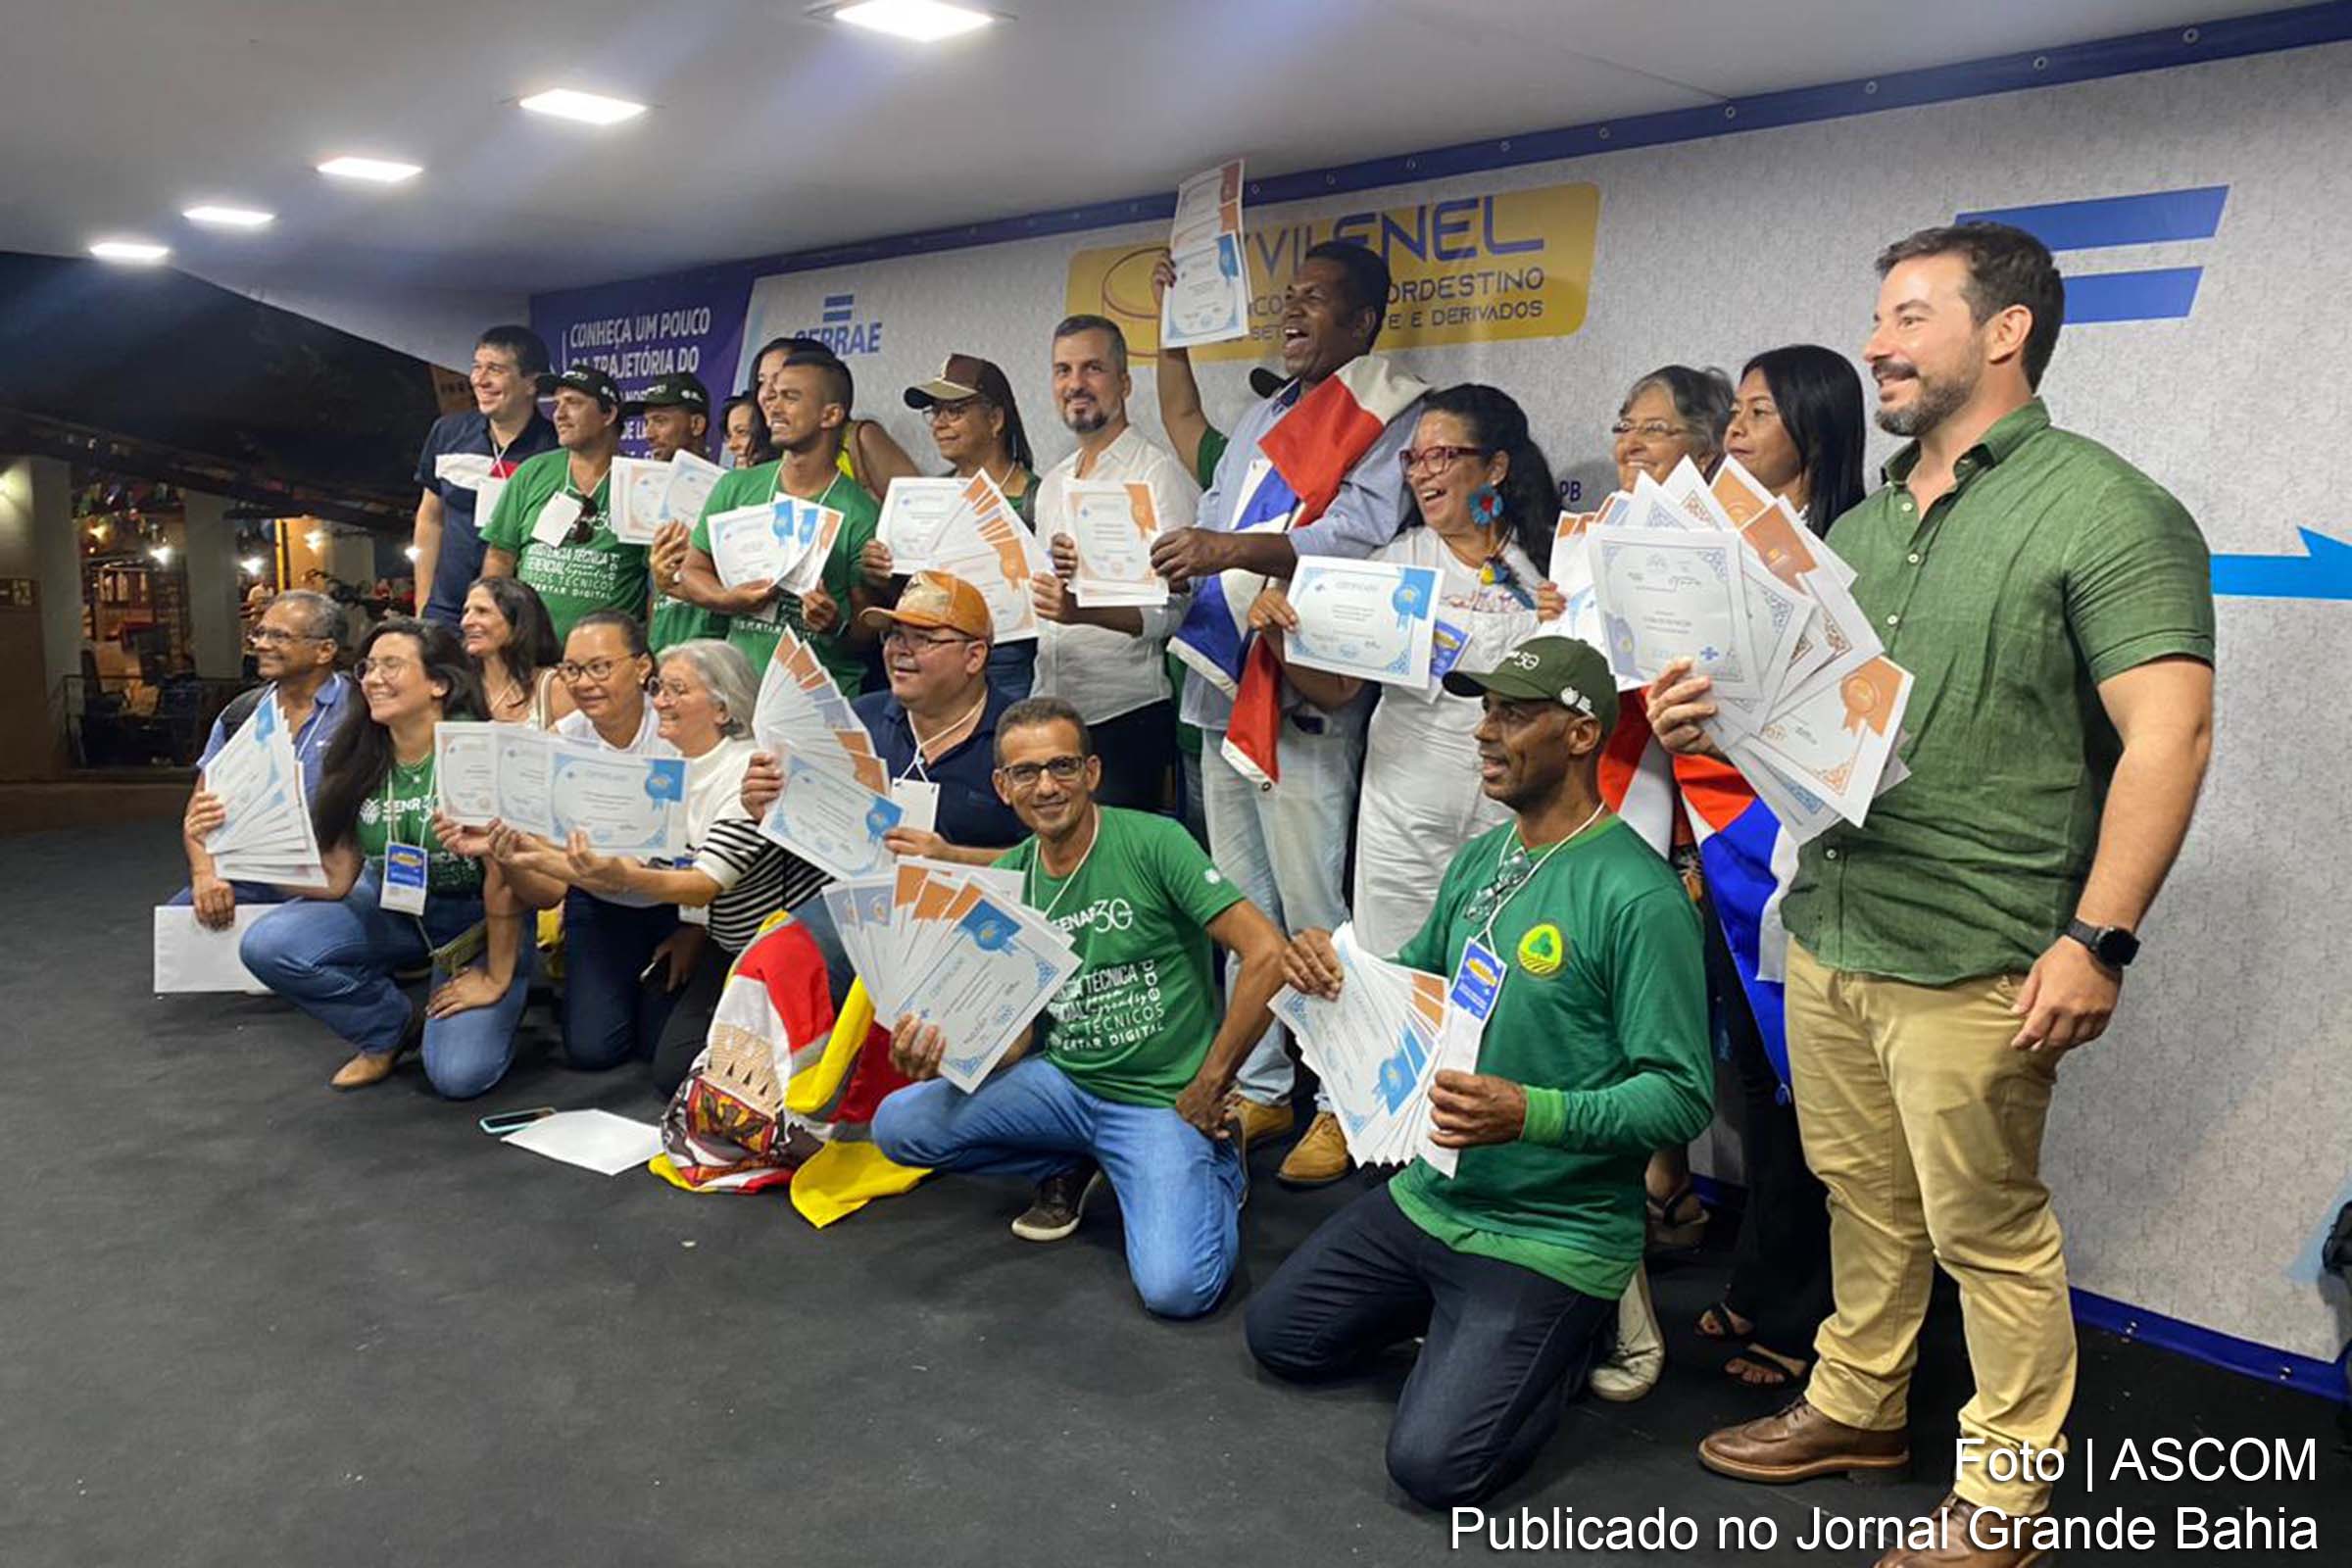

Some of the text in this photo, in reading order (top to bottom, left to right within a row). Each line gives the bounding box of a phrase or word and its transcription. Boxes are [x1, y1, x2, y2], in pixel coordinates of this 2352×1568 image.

[1333, 195, 1545, 265] ENEL
[1388, 267, 1545, 305] ORDESTINO
[570, 307, 710, 350] CONHEÇA UM POUCO
[1410, 312, 1424, 327] E
[1432, 300, 1544, 326] DERIVADOS
[593, 345, 674, 379] TRAJETÓRIA
[677, 346, 700, 372] DO
[1108, 1022, 1165, 1047] DIGITAL
